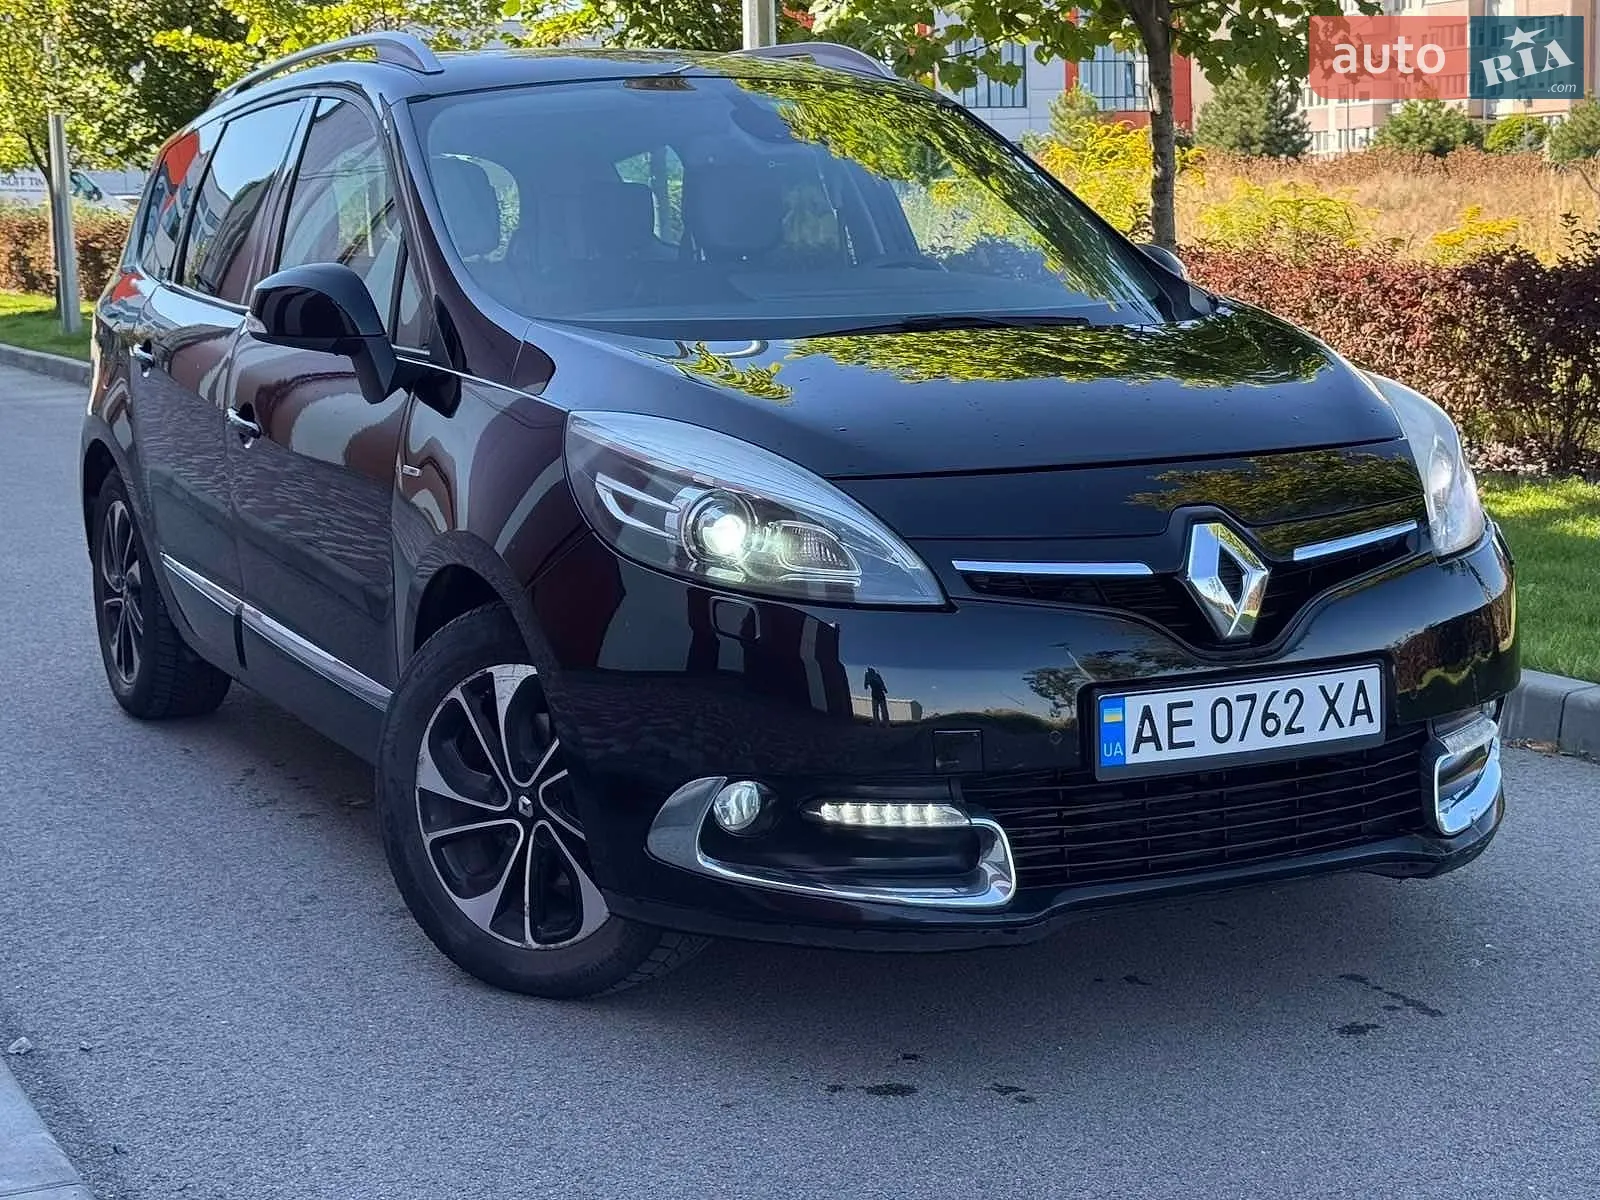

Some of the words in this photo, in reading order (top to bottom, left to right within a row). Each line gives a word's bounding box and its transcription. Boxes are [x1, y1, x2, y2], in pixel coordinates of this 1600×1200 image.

[1131, 700, 1195, 754] AE
[1210, 688, 1304, 744] 0762
[1318, 679, 1374, 731] XA
[1103, 741, 1124, 757] UA
